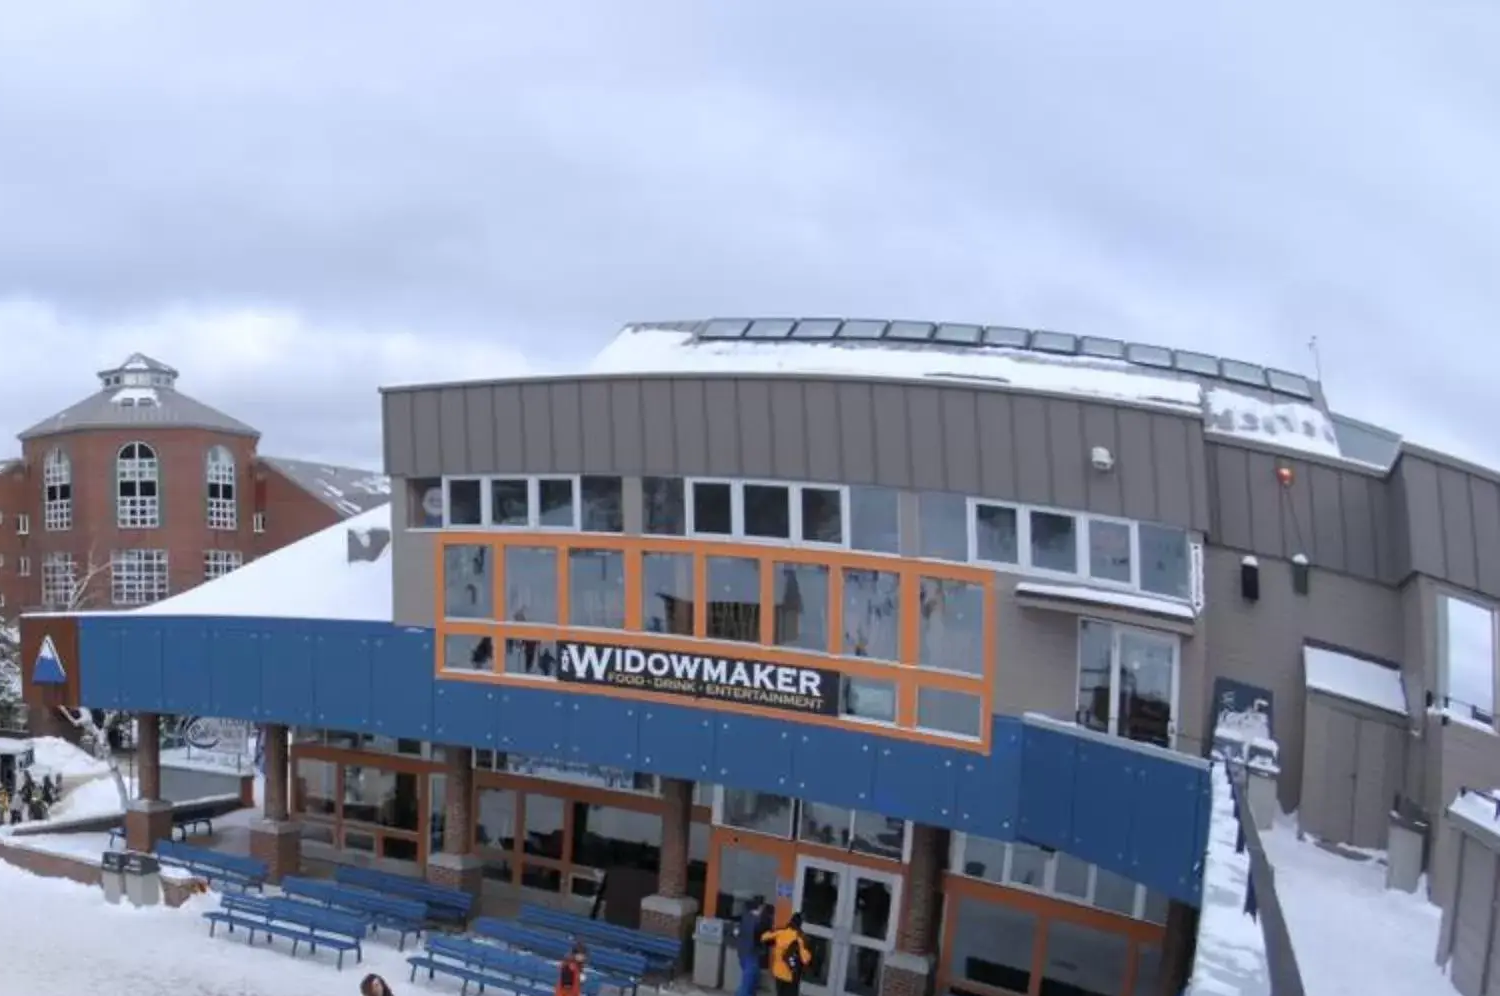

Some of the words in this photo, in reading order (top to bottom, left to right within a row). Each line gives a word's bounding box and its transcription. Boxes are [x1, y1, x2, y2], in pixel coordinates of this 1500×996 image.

[566, 644, 821, 696] WIDOWMAKER
[607, 671, 645, 685] FOOD
[654, 678, 697, 692] DRINK
[706, 683, 823, 709] ENTERTAINMENT
